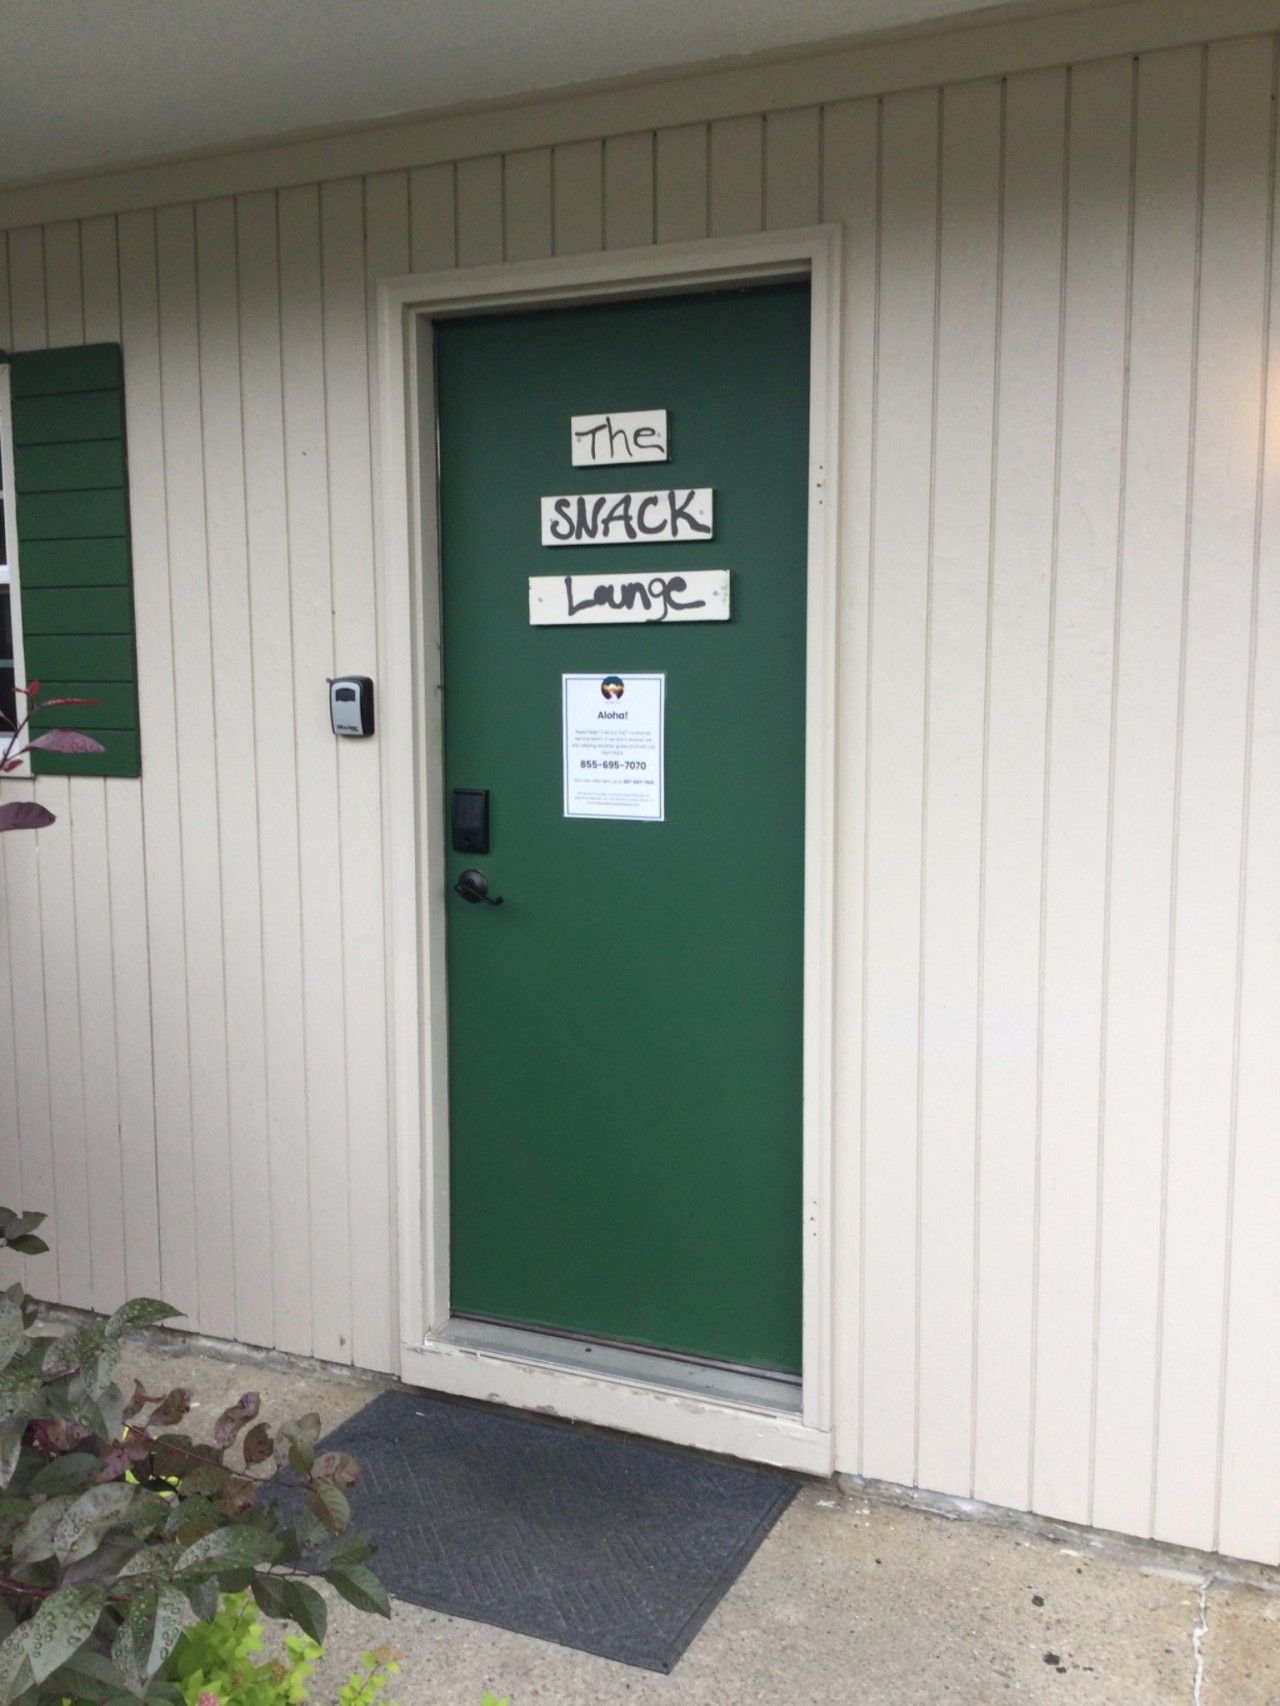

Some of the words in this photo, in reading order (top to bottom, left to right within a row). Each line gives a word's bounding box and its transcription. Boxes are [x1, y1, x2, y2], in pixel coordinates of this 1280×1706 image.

[575, 416, 665, 460] The
[550, 490, 711, 540] SNACK
[597, 711, 629, 720] Aloha!
[580, 760, 647, 770] 855-695-7070
